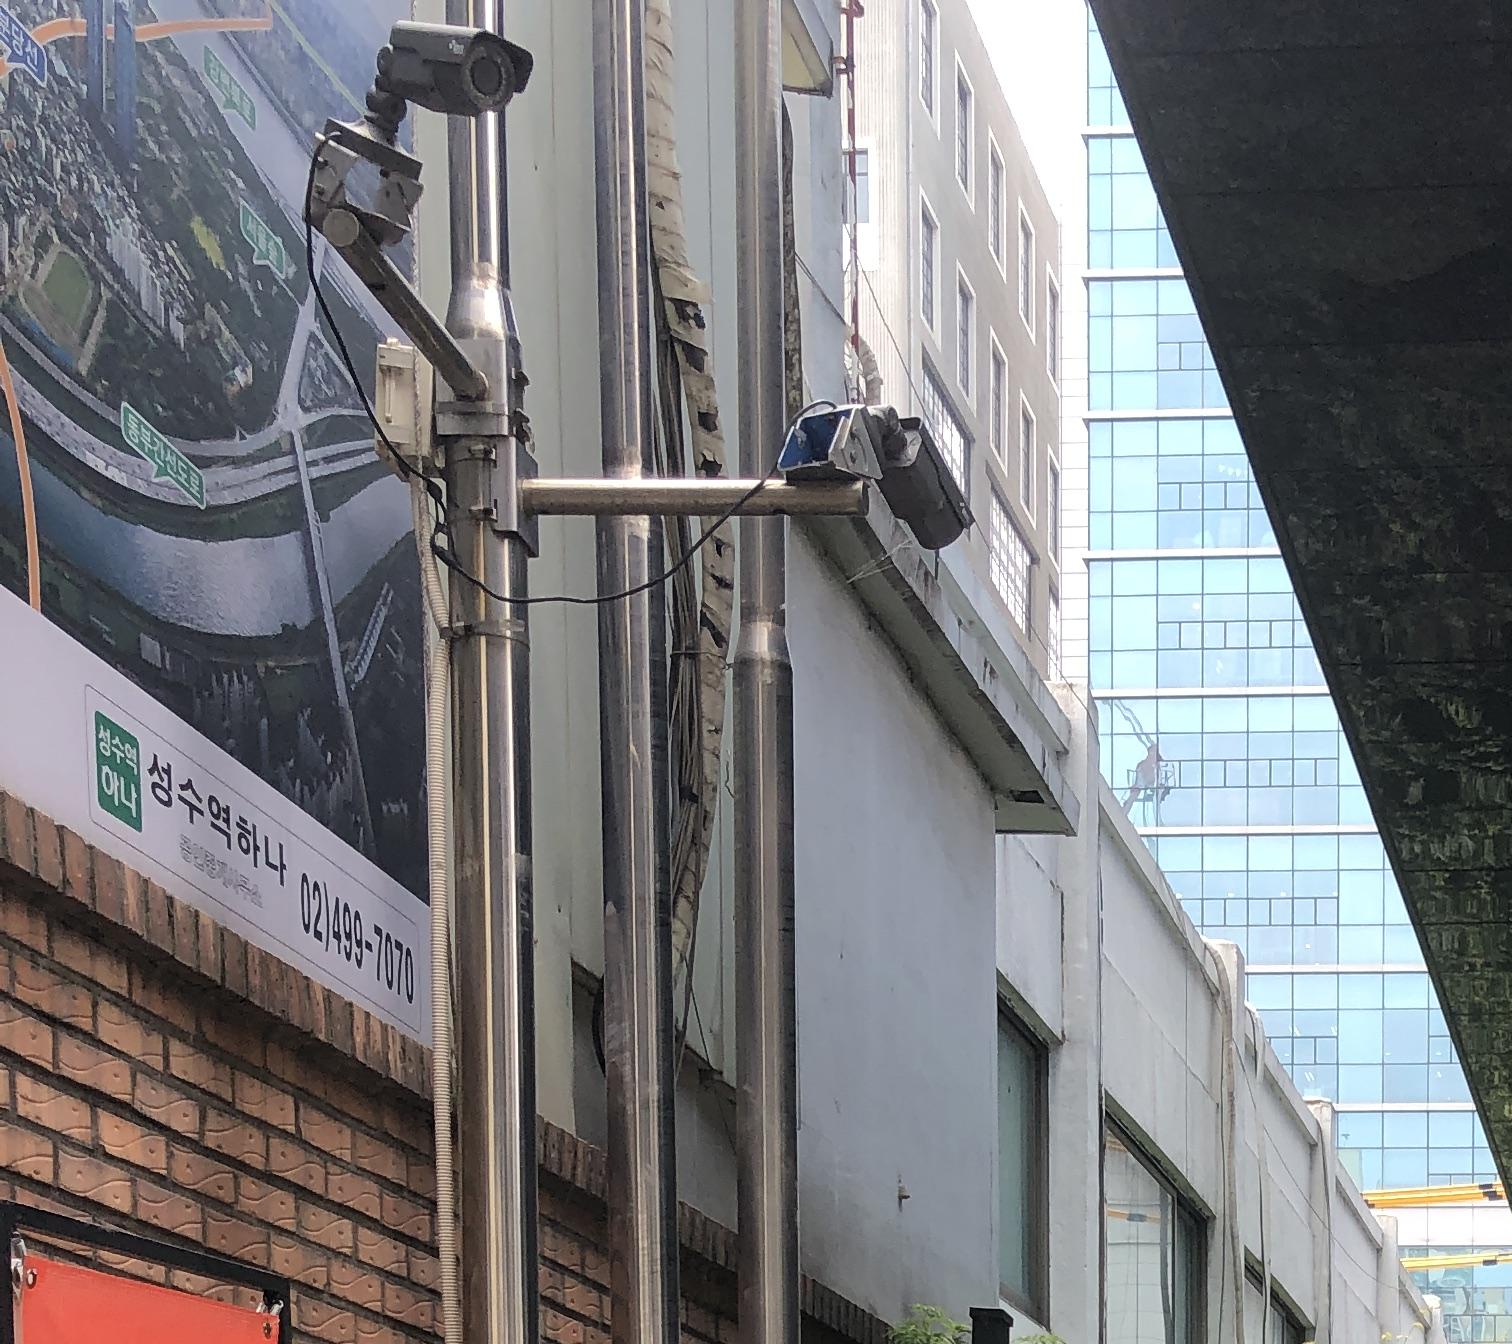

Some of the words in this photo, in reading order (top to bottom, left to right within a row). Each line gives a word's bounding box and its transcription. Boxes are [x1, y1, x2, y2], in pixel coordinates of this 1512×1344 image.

[127, 413, 200, 498] 동부간선도로
[99, 725, 138, 775] 성수역
[147, 753, 287, 887] 성수역하나
[301, 873, 414, 1004] 02)499-7070
